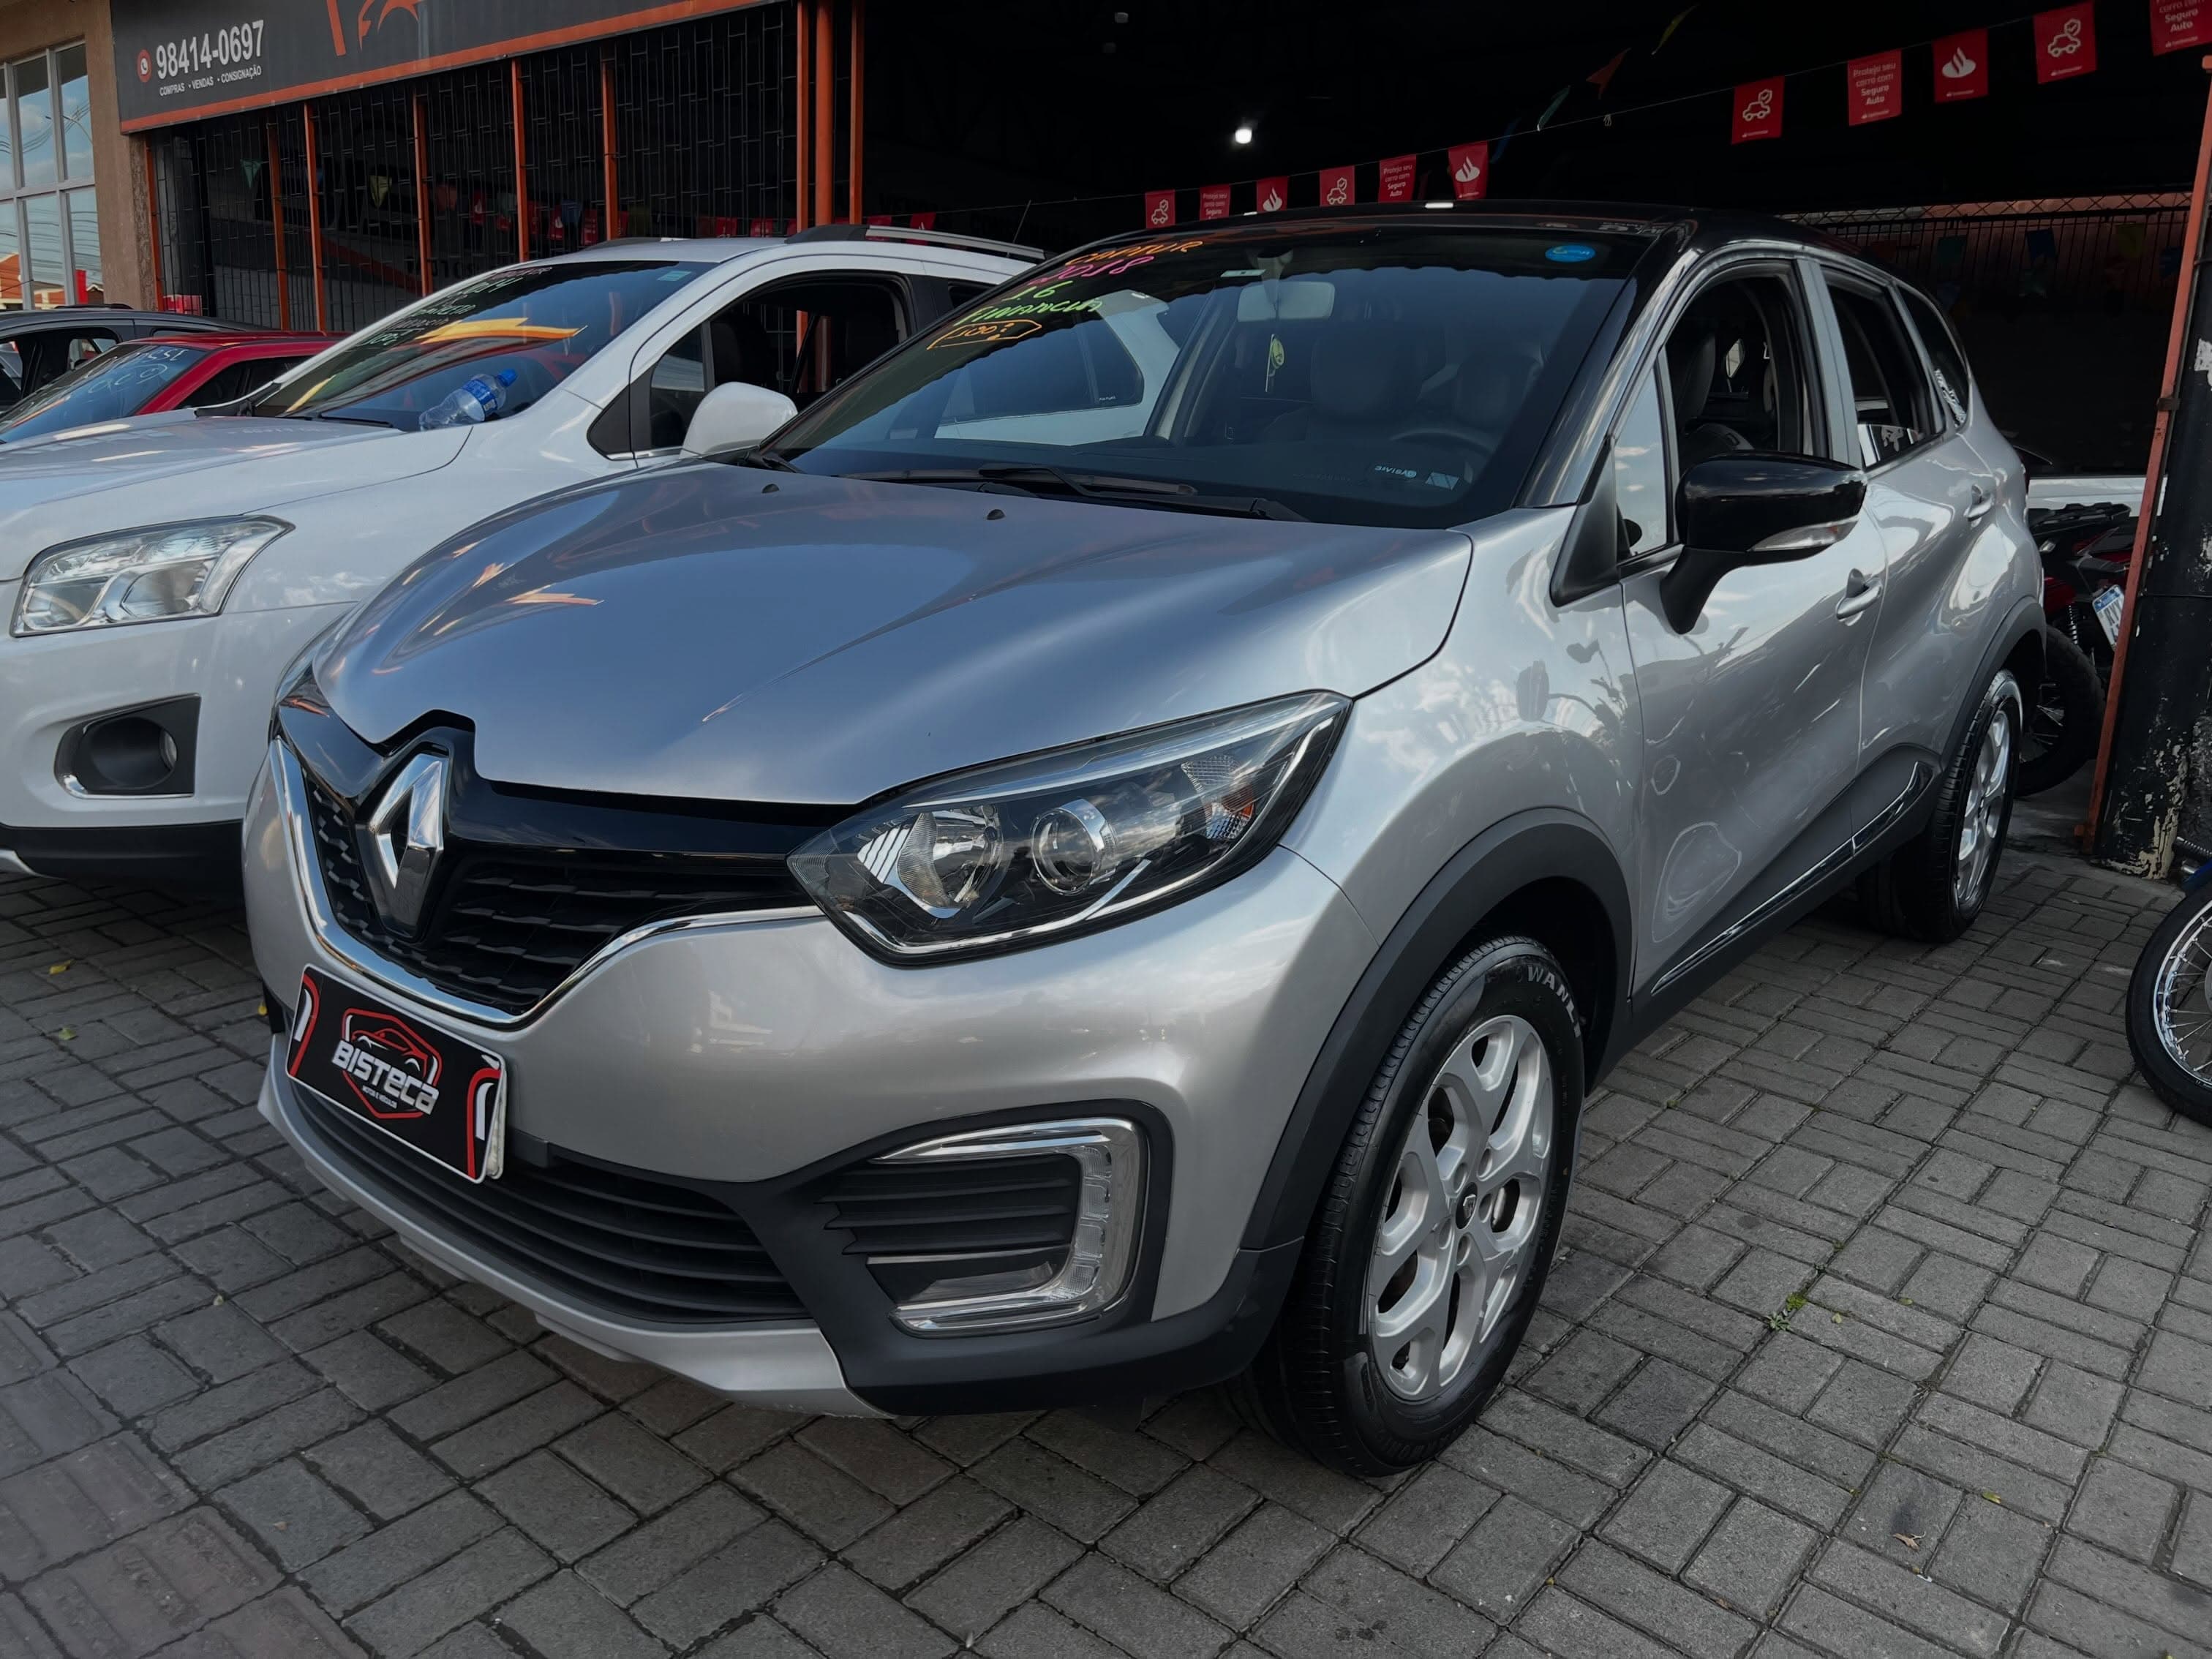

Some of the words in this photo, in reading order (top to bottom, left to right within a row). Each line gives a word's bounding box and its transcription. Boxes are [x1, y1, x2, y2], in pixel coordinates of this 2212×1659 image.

[2165, 8, 2199, 23] Seguro
[2170, 20, 2194, 33] Auto
[156, 20, 264, 80] 98414-0697
[159, 83, 185, 97] COMPRAS
[192, 76, 214, 90] VENDAS
[221, 64, 262, 83] CONSIGNAÇÃO
[1861, 85, 1889, 97] Seguro
[1866, 96, 1885, 105] Auto
[1026, 255, 1156, 286] 2018
